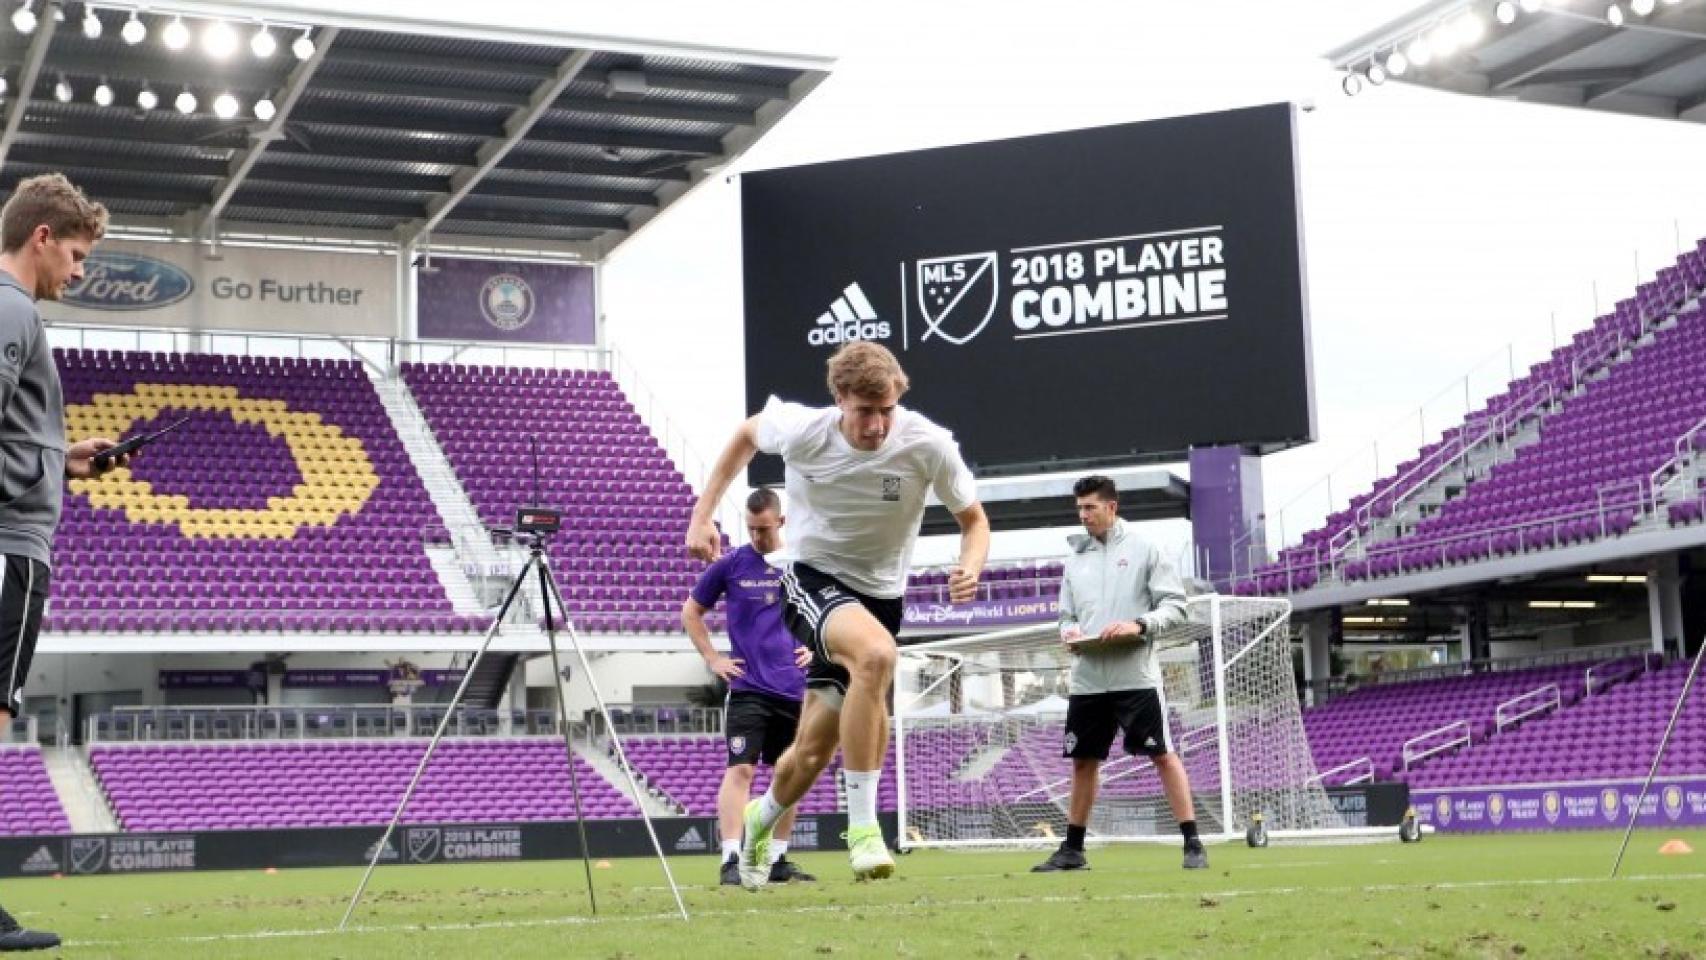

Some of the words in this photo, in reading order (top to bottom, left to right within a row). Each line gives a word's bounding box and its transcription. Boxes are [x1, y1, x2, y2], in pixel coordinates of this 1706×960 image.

[924, 262, 966, 285] MLS
[1011, 252, 1084, 286] 2018
[1094, 236, 1224, 277] PLAYER
[66, 263, 160, 300] Ford
[211, 276, 253, 299] Go
[259, 278, 364, 305] Further
[1011, 268, 1228, 330] COMBINE
[807, 320, 891, 346] adidas
[109, 852, 195, 869] COMBINE
[444, 842, 521, 858] COMBINE
